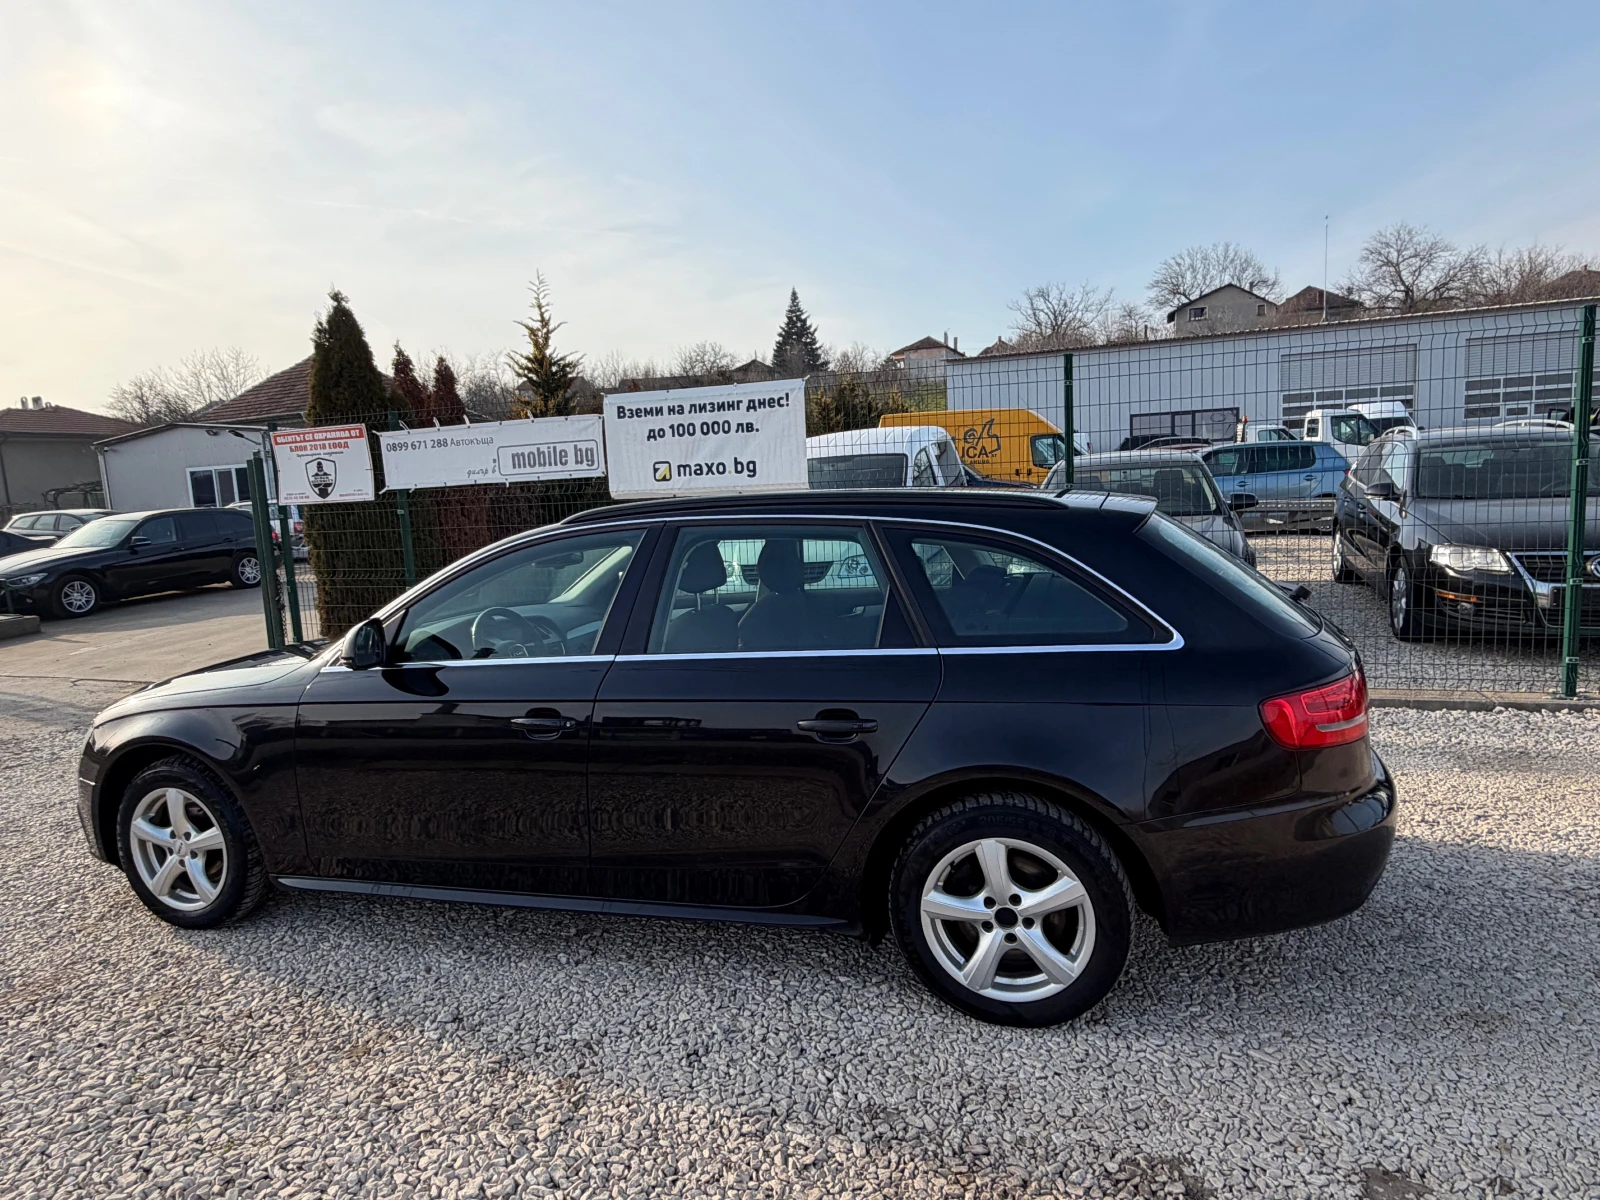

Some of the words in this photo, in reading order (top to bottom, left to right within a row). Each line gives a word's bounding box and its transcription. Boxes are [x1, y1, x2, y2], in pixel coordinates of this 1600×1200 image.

[617, 405, 664, 420] Вземи
[667, 403, 685, 416] на
[688, 400, 744, 414] лизинг
[746, 393, 790, 412] днес!
[304, 433, 313, 441] СЕ
[314, 431, 350, 440] ОХРАНЯВА
[350, 429, 360, 437] ОТ
[646, 427, 666, 442] до
[668, 423, 697, 438] 100
[700, 420, 732, 435] 000
[735, 422, 760, 434] лв.
[309, 443, 327, 451] 2018
[328, 441, 350, 450] ЕООД
[386, 441, 409, 452] 0899
[411, 440, 428, 450] 671
[430, 438, 448, 449] 288
[450, 436, 494, 447] Автокъща
[511, 445, 568, 469] mobile
[574, 444, 595, 467] bg
[677, 457, 757, 478] maxo.bg
